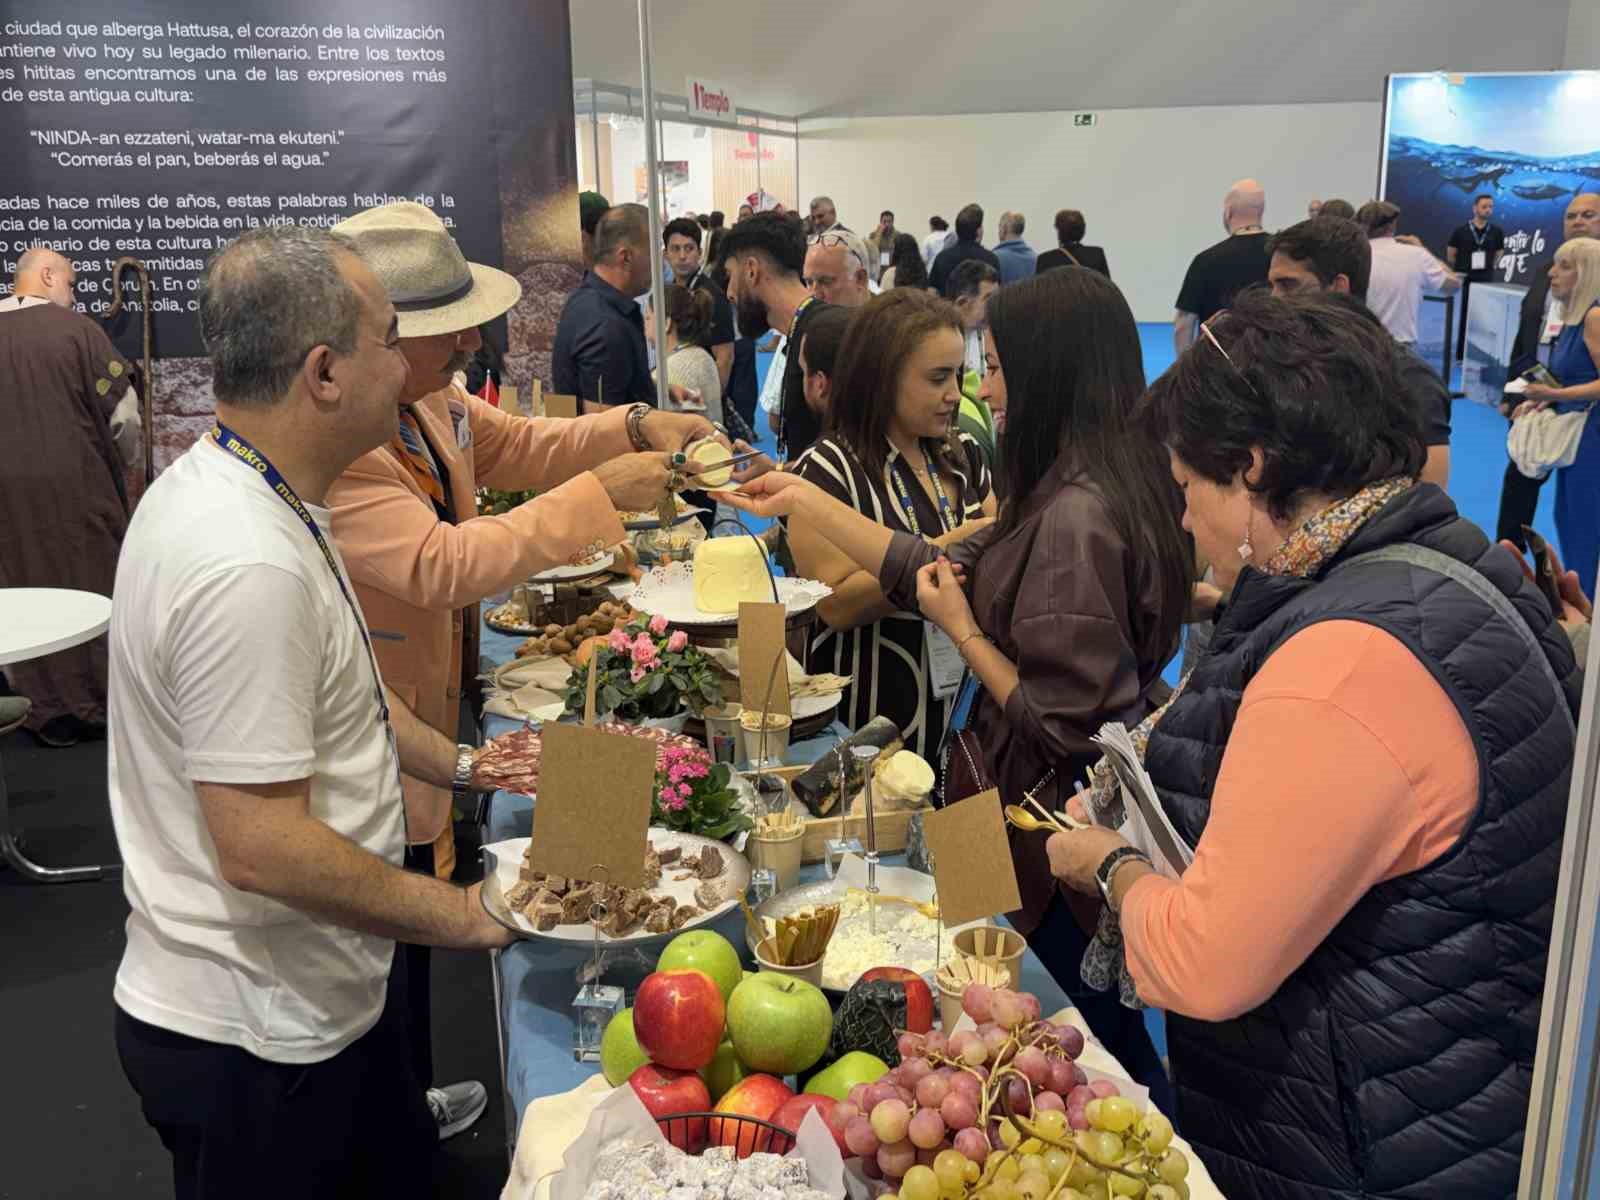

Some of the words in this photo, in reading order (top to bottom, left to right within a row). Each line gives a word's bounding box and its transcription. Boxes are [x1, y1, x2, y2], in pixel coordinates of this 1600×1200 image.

[5, 21, 62, 35] ciudad
[66, 24, 98, 39] que
[102, 22, 164, 40] alberga
[168, 22, 233, 39] Hattusa,
[237, 24, 251, 37] el
[255, 24, 318, 40] corazón
[322, 24, 343, 38] de
[347, 24, 360, 38] la
[364, 24, 444, 40] civilización
[63, 43, 96, 58] vivo
[104, 43, 135, 62] hoy
[142, 47, 162, 59] su
[169, 44, 226, 63] legado
[234, 45, 310, 59] milenario.
[318, 45, 359, 60] Entre
[366, 46, 389, 61] los
[396, 48, 445, 61] textos
[24, 65, 75, 80] hititas
[85, 67, 196, 80] encontramos
[205, 69, 237, 80] una
[245, 66, 266, 80] de
[276, 67, 298, 81] las
[307, 67, 404, 84] expresiones
[413, 68, 447, 82] más
[2, 87, 23, 101] de
[28, 88, 65, 102] esta
[69, 88, 131, 105] antigua
[135, 88, 193, 102] cultura:
[124, 131, 194, 146] ezzateni,
[198, 132, 275, 144] watar-ma
[137, 152, 151, 166] el
[155, 155, 190, 169] pan,
[194, 152, 259, 166] beberás
[264, 152, 277, 165] el
[48, 195, 89, 209] hace
[97, 194, 140, 208] miles
[147, 194, 168, 208] de
[176, 194, 220, 210] años,
[227, 194, 271, 208] estas
[278, 193, 347, 210] palabras
[441, 194, 455, 208] la
[28, 217, 49, 230] de
[53, 216, 68, 230] la
[71, 216, 131, 230] comida
[135, 218, 143, 232] y
[148, 216, 162, 229] la
[165, 215, 219, 229] bebida
[223, 217, 243, 228] en
[246, 214, 260, 228] la
[14, 237, 83, 252] culinario
[88, 237, 110, 250] de
[116, 237, 152, 250] esta
[157, 236, 212, 249] cultura
[77, 279, 98, 292] de
[163, 277, 183, 291] En
[90, 299, 112, 314] de
[227, 439, 268, 472] makro
[276, 483, 311, 522] makro
